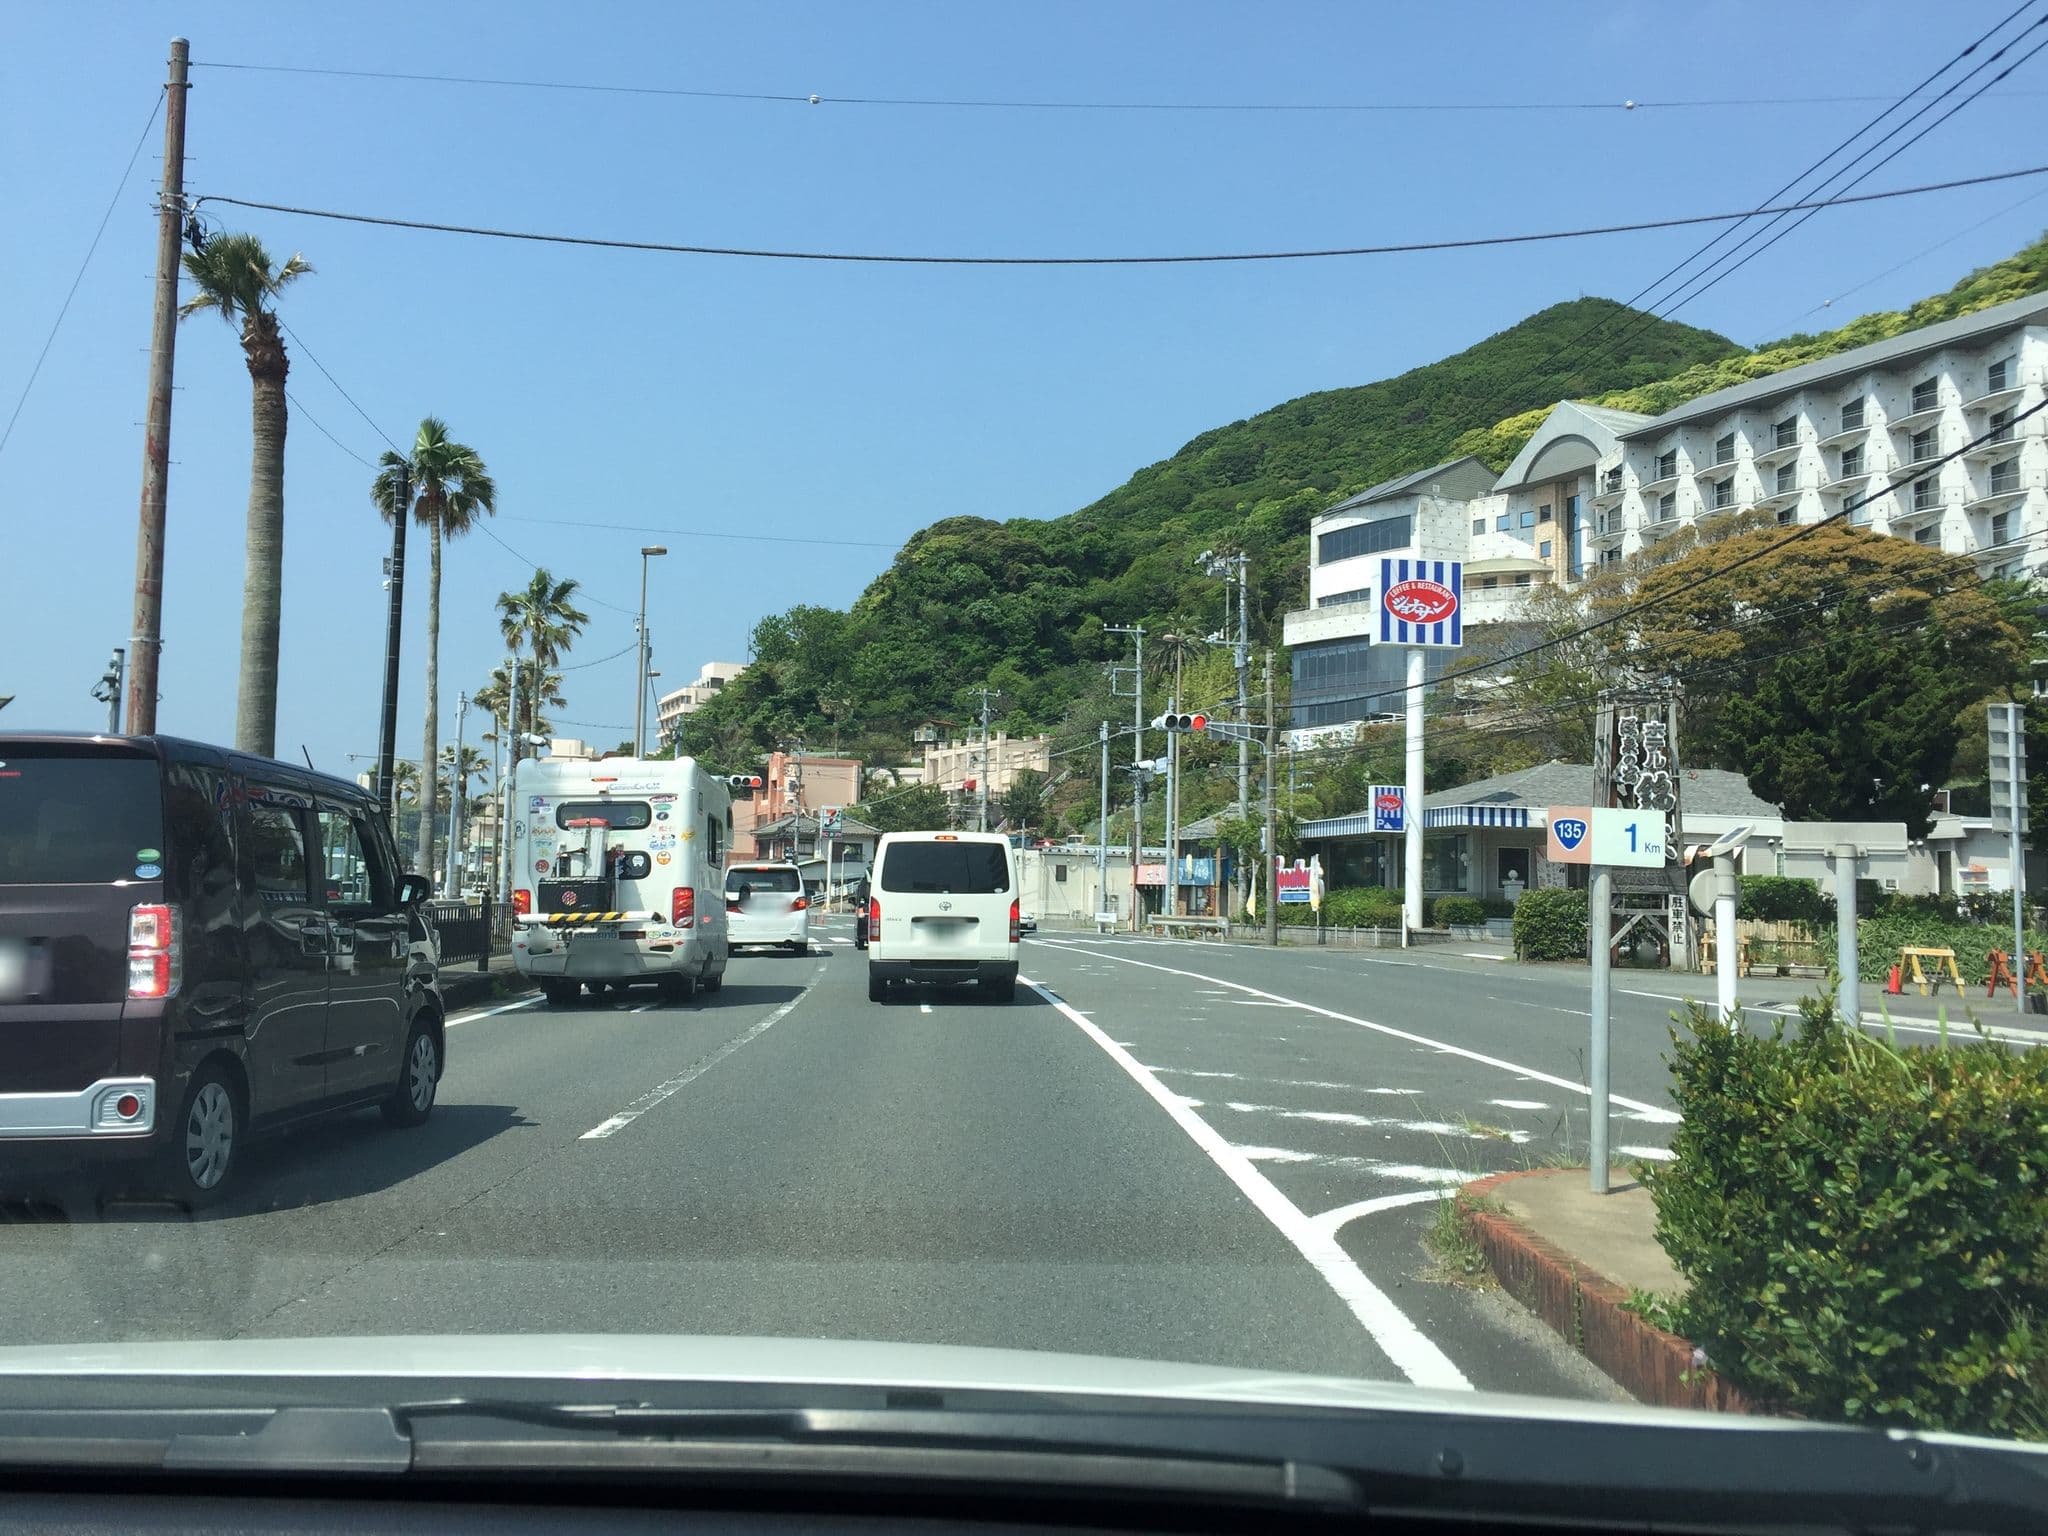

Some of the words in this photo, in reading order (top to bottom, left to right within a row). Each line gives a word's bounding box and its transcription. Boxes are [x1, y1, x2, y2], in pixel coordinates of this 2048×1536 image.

[1389, 583, 1410, 598] COFFEE
[1417, 582, 1454, 601] RESTAURANT
[1643, 721, 1667, 769] ホテル
[1376, 818, 1385, 829] P
[1558, 822, 1582, 839] 135
[1624, 823, 1637, 853] 1
[1644, 842, 1661, 854] Km
[1671, 896, 1685, 945] 駐車禁止
